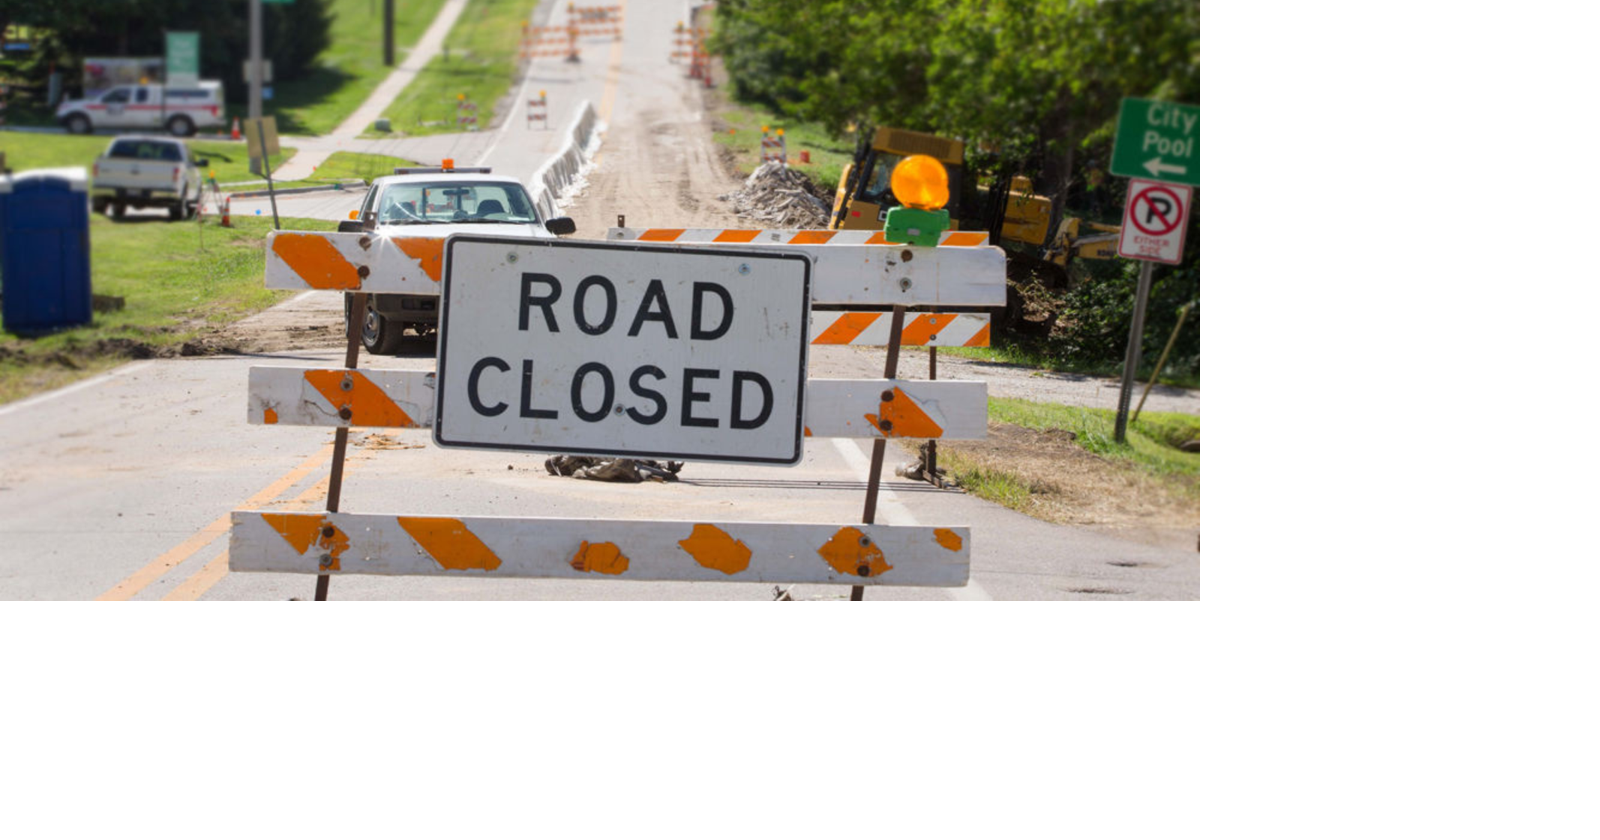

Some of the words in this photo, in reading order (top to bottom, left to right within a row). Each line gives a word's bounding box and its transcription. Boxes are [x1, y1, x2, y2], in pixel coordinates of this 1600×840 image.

[1148, 102, 1197, 135] City
[1143, 131, 1194, 157] Pool
[1133, 235, 1170, 247] EITHER
[1139, 245, 1162, 255] SIDE
[518, 272, 734, 341] ROAD
[466, 356, 774, 430] CLOSED
